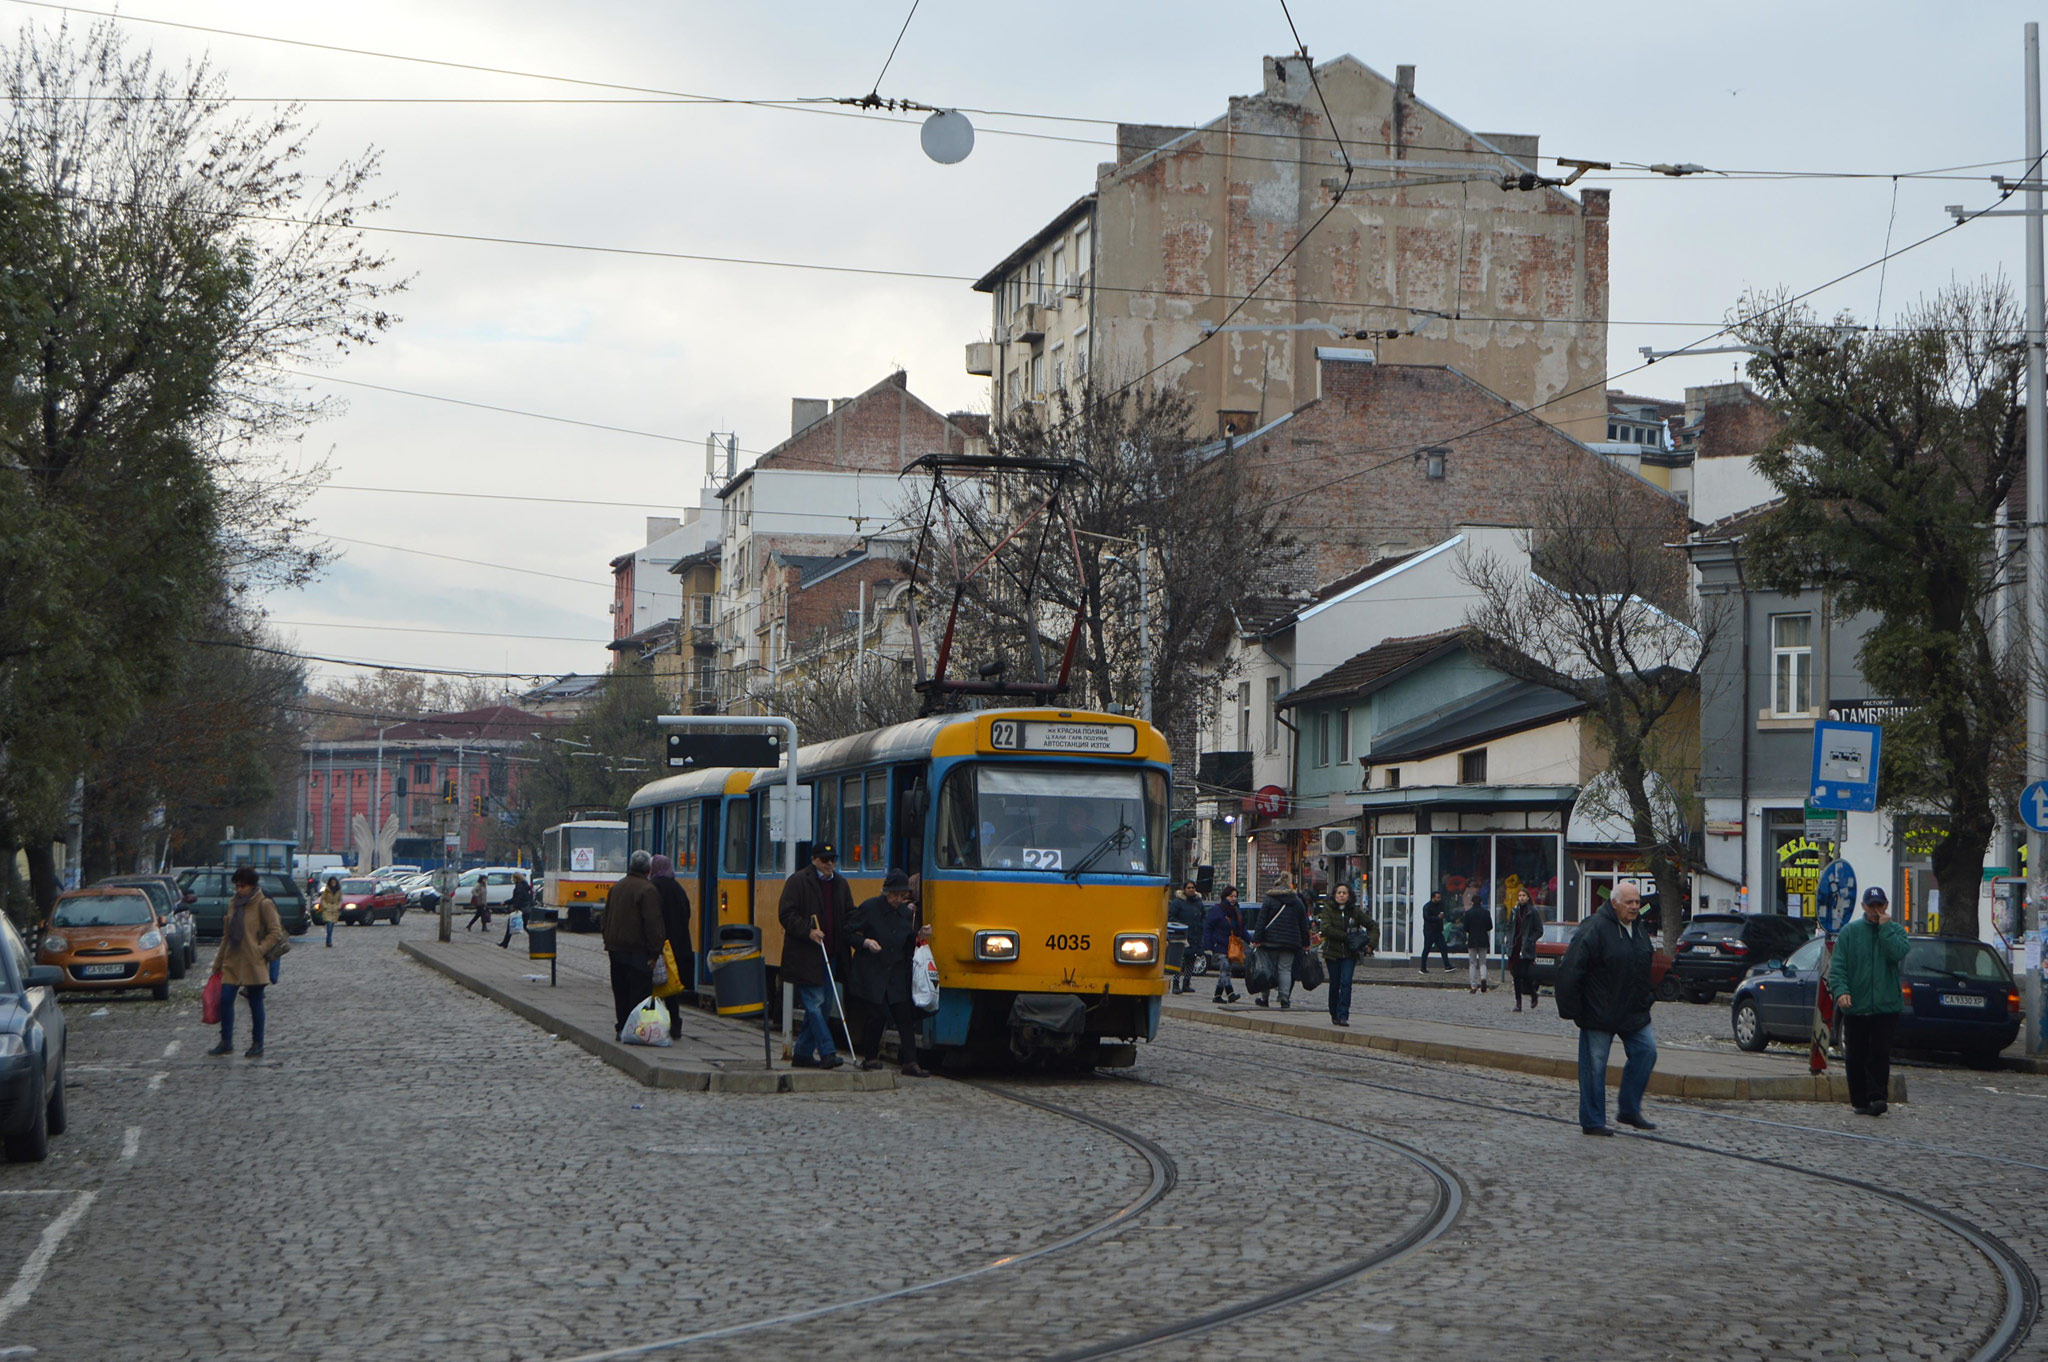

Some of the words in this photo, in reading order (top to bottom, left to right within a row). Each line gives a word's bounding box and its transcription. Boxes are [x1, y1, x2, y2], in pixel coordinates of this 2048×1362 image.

[993, 724, 1013, 746] 22
[1057, 727, 1081, 735] КРАСНА
[1043, 740, 1089, 748] АВТОСТАНЦИЯ
[1024, 850, 1060, 870] 22
[1045, 934, 1091, 951] 4035
